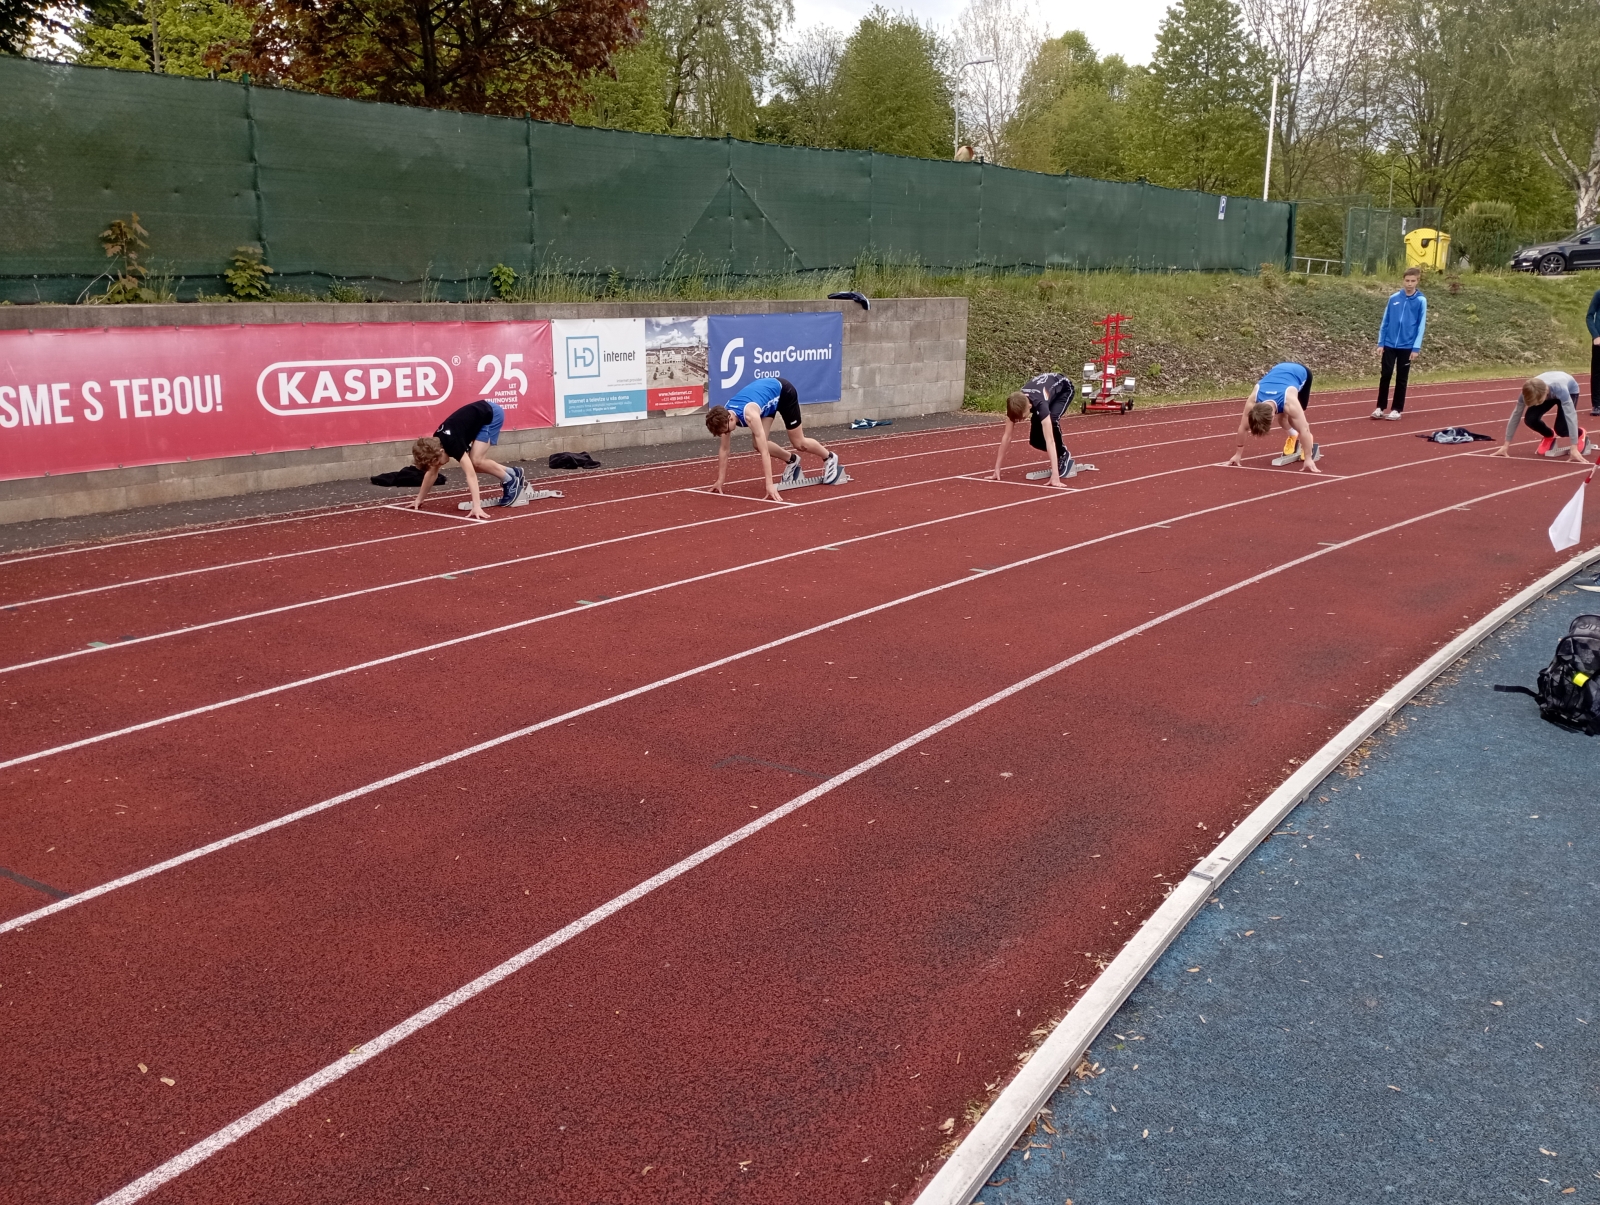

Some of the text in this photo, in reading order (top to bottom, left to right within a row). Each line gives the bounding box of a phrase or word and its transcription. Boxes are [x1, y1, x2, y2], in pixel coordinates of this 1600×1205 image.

[573, 347, 595, 368] HD
[603, 350, 636, 362] internet
[753, 343, 833, 364] SaarGummi
[477, 353, 528, 396] 25
[753, 368, 781, 379] Group
[277, 366, 440, 406] KASPER
[0, 374, 223, 429] SME S TEBOU!
